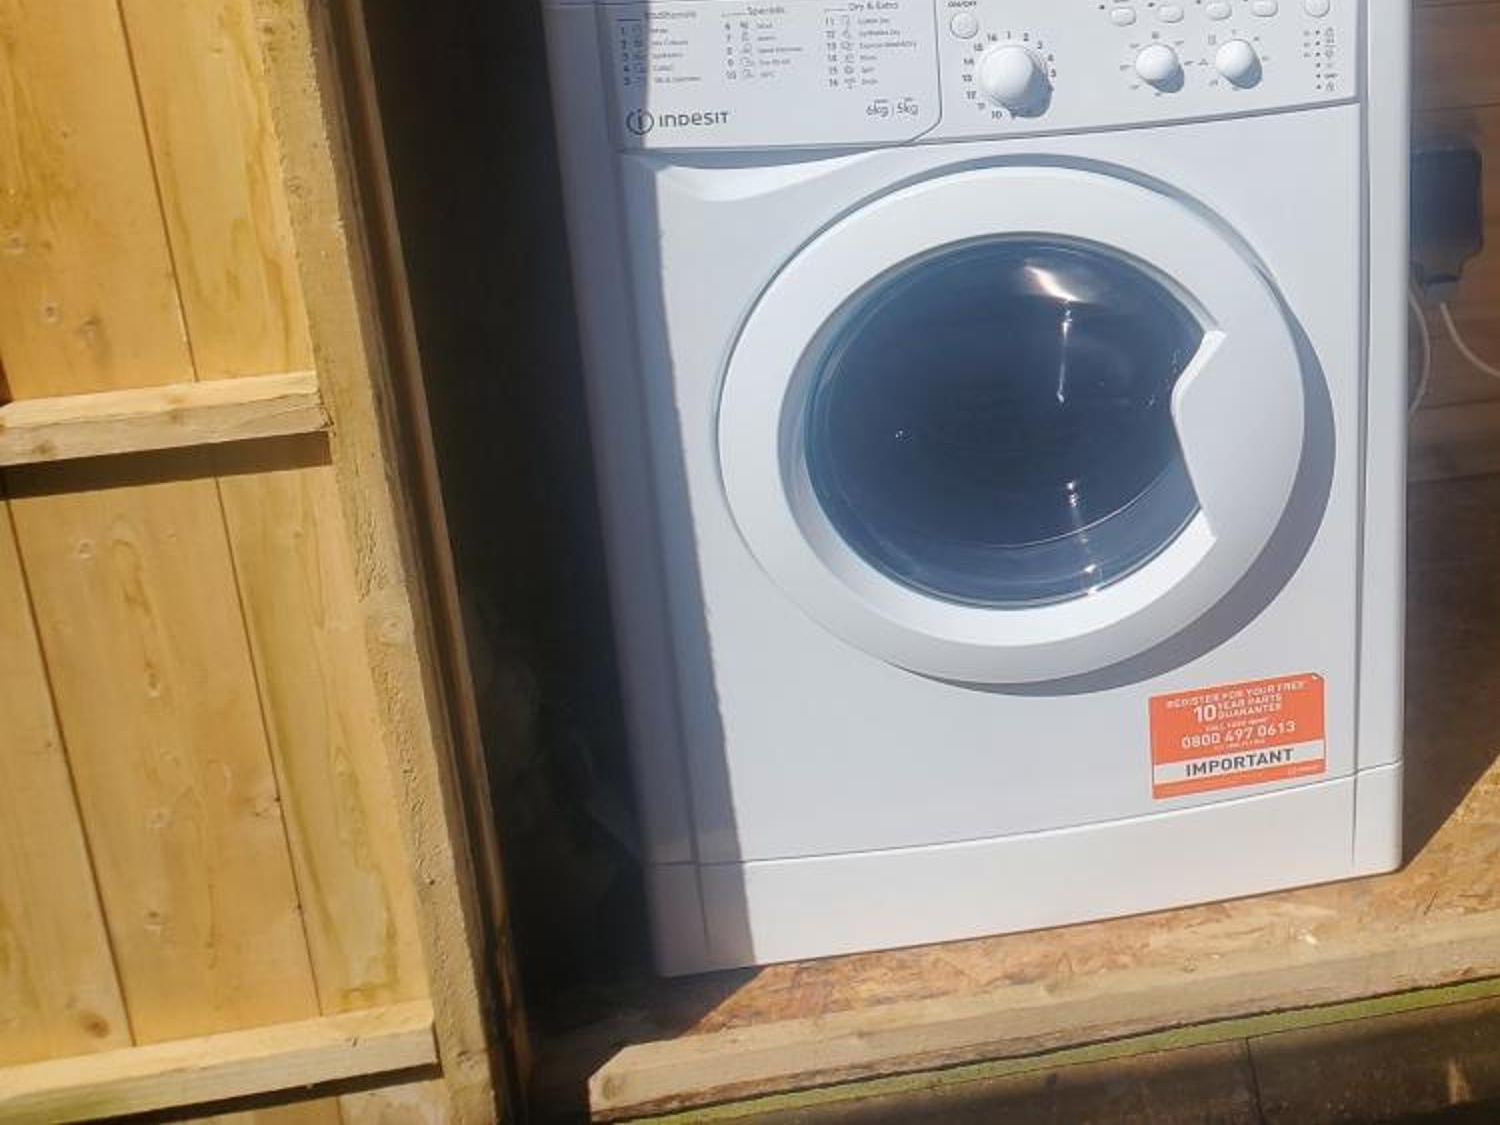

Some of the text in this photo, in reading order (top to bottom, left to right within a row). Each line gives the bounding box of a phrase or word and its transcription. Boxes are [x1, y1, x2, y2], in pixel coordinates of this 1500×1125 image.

[847, 2, 864, 13] Dry
[658, 110, 729, 129] INDESIT
[1246, 683, 1275, 696] YOUR
[1217, 693, 1283, 711] YEAR PARTS
[1217, 702, 1282, 720] GUARANTEE
[1193, 703, 1217, 724] 10
[1181, 731, 1222, 750] 0800
[1185, 749, 1294, 777] IMPORTANT
